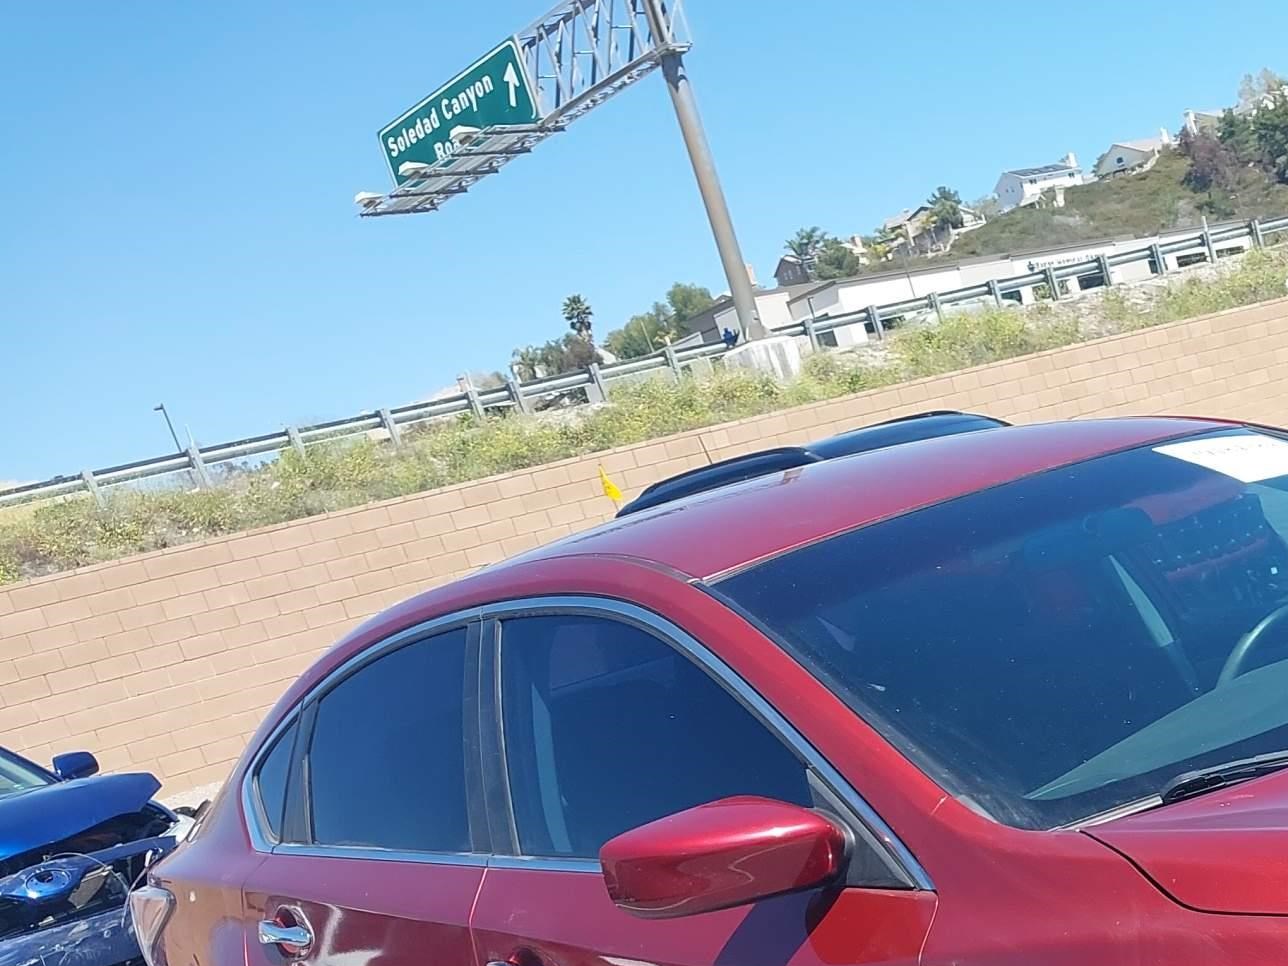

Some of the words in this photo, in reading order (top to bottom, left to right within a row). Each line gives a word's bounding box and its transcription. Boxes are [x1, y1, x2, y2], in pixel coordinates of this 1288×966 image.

[387, 107, 441, 158] Soledad
[441, 75, 494, 120] Canyon
[433, 138, 461, 161] Roa
